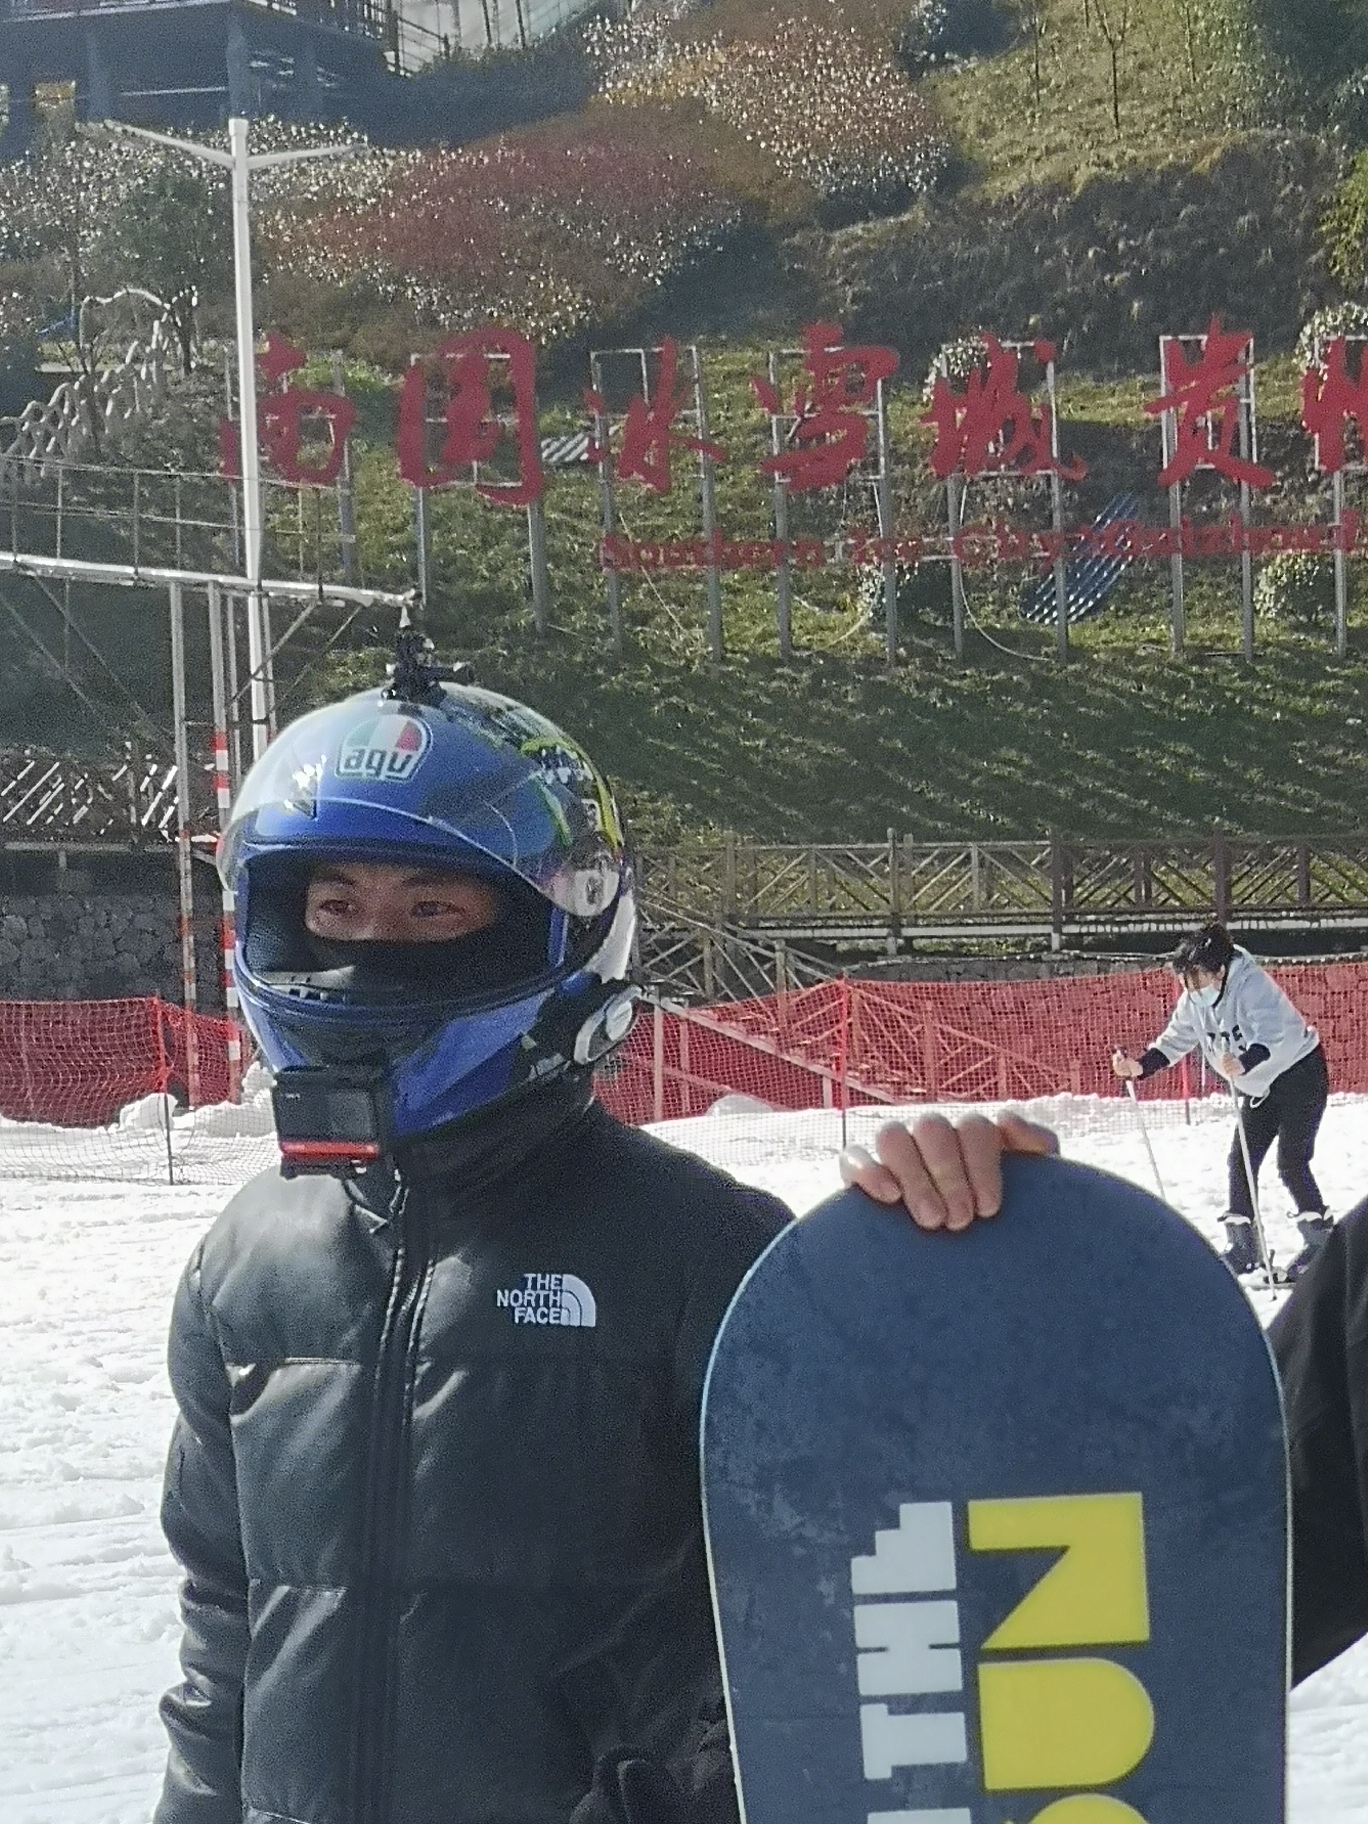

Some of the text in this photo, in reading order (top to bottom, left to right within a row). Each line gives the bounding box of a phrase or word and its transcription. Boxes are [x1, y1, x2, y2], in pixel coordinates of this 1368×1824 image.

[524, 1273, 562, 1290] THE
[496, 1289, 562, 1308] NORTH
[514, 1307, 562, 1325] FACE
[850, 1501, 969, 1780] THE
